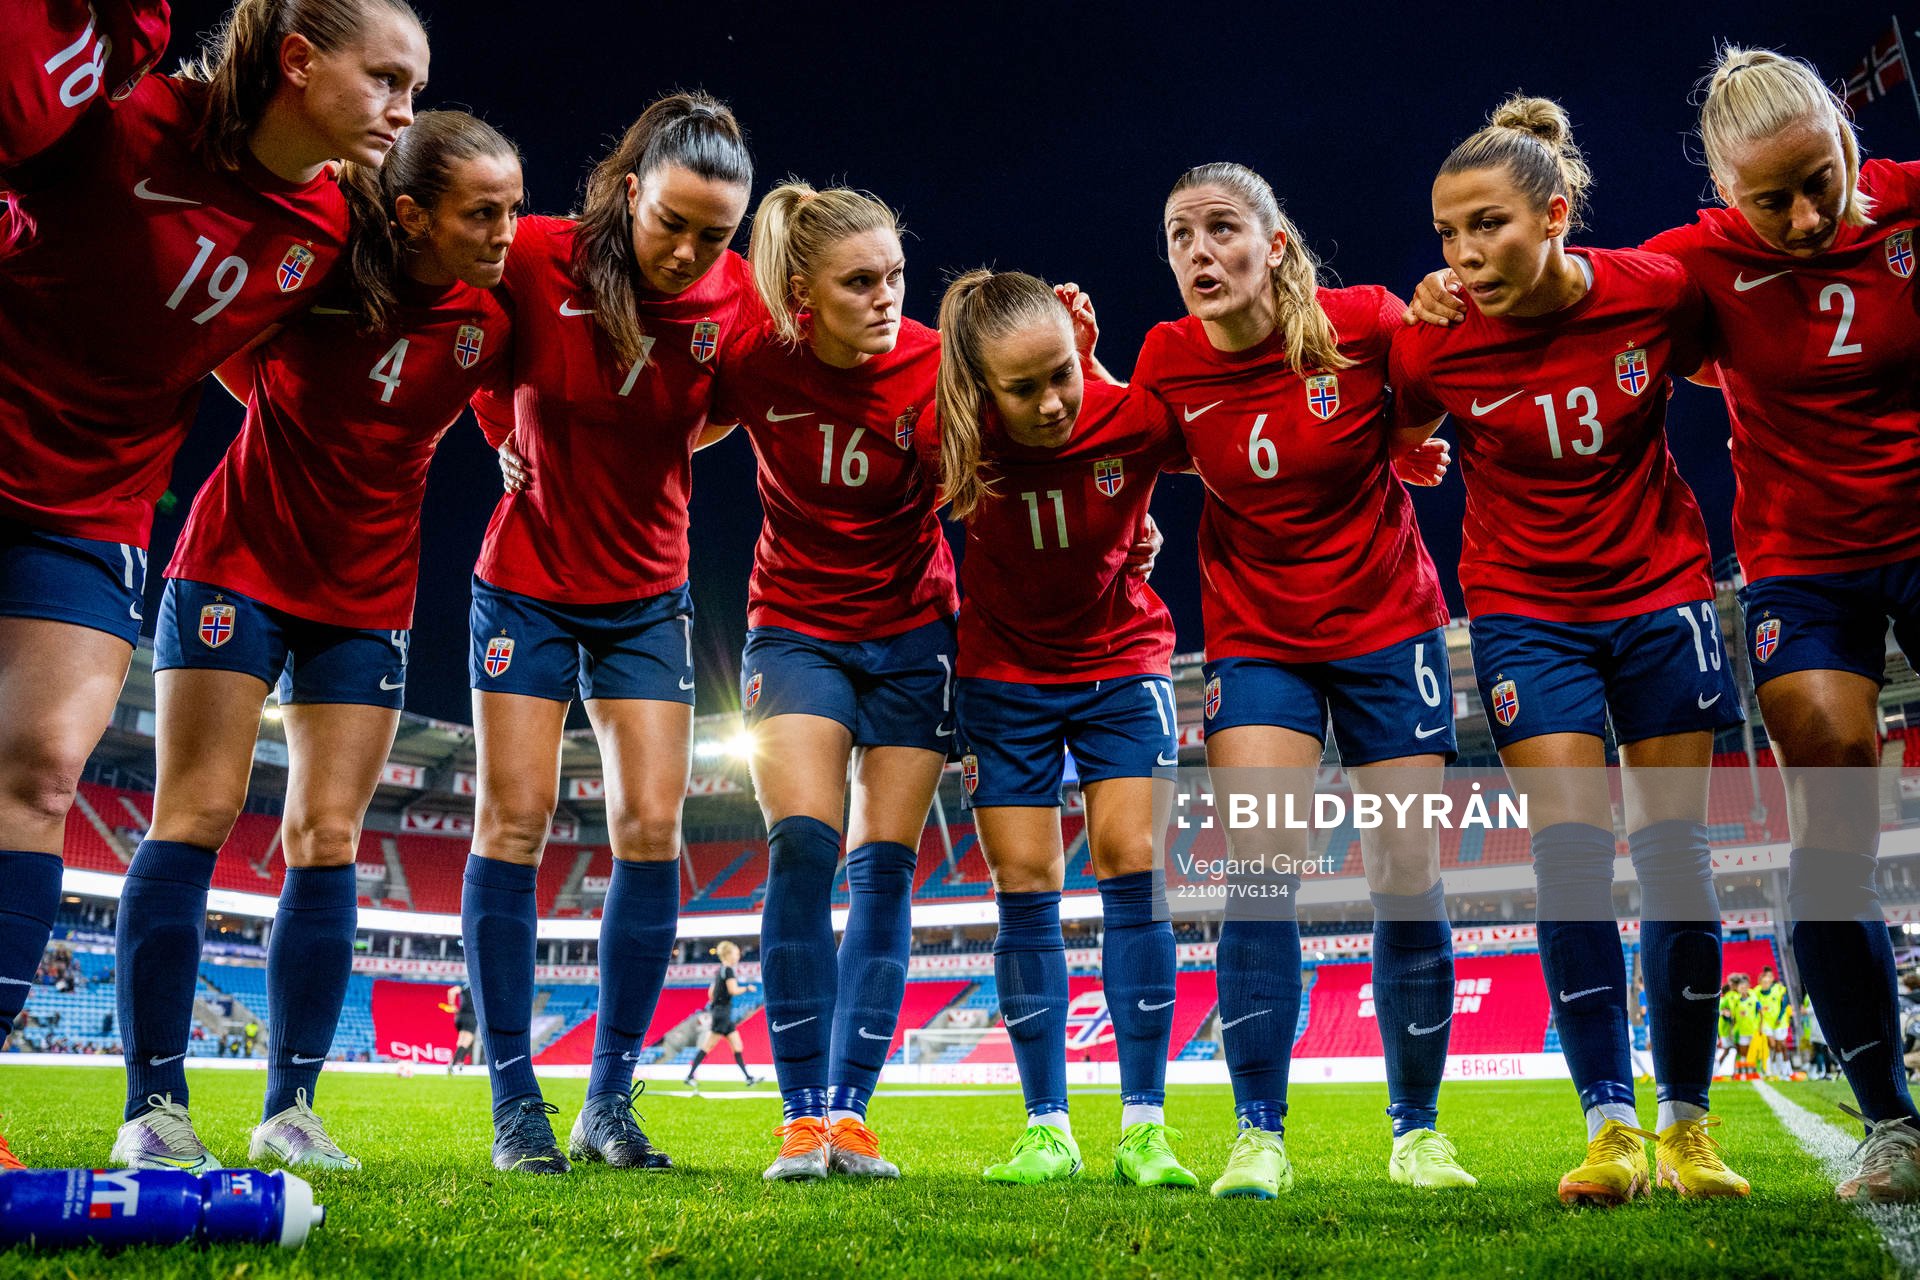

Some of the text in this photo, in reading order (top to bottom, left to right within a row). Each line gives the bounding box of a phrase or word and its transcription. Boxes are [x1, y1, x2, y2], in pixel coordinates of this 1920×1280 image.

[44, 0, 113, 108] 18
[165, 235, 249, 325] 19
[1818, 283, 1863, 358] 2
[368, 337, 411, 403] 4
[617, 334, 657, 397] 7
[818, 423, 870, 487] 16
[1248, 413, 1279, 479] 6
[1534, 386, 1604, 459] 13
[1021, 489, 1070, 550] 11
[1677, 602, 1722, 673] 13
[1414, 643, 1441, 708] 6
[1142, 680, 1179, 738] 11
[404, 812, 474, 834] VG
